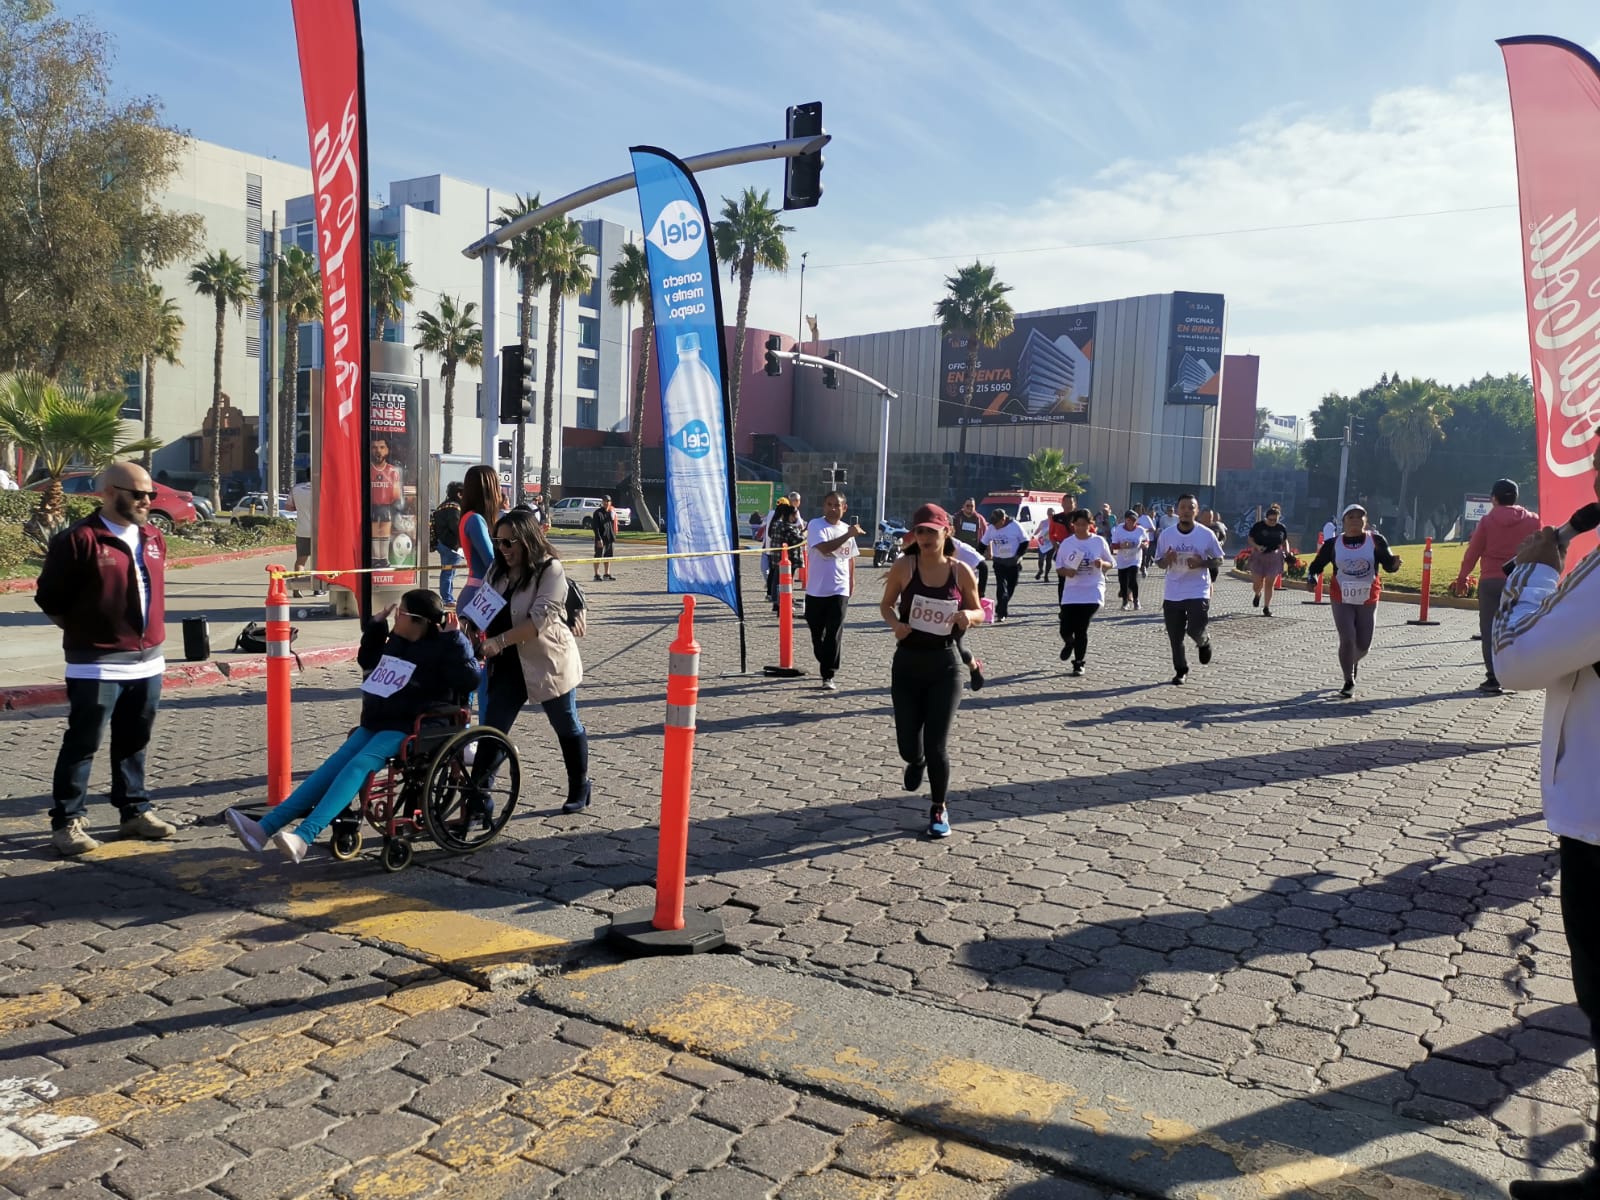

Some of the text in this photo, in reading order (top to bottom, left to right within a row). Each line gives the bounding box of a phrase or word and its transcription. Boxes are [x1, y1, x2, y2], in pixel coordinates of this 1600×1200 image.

[1191, 326, 1222, 334] RENTA
[948, 361, 982, 370] OFICAS
[947, 372, 964, 383] EN
[976, 384, 988, 393] 215
[990, 383, 1011, 392] 5050
[371, 409, 403, 420] NES
[473, 594, 497, 620] 0741
